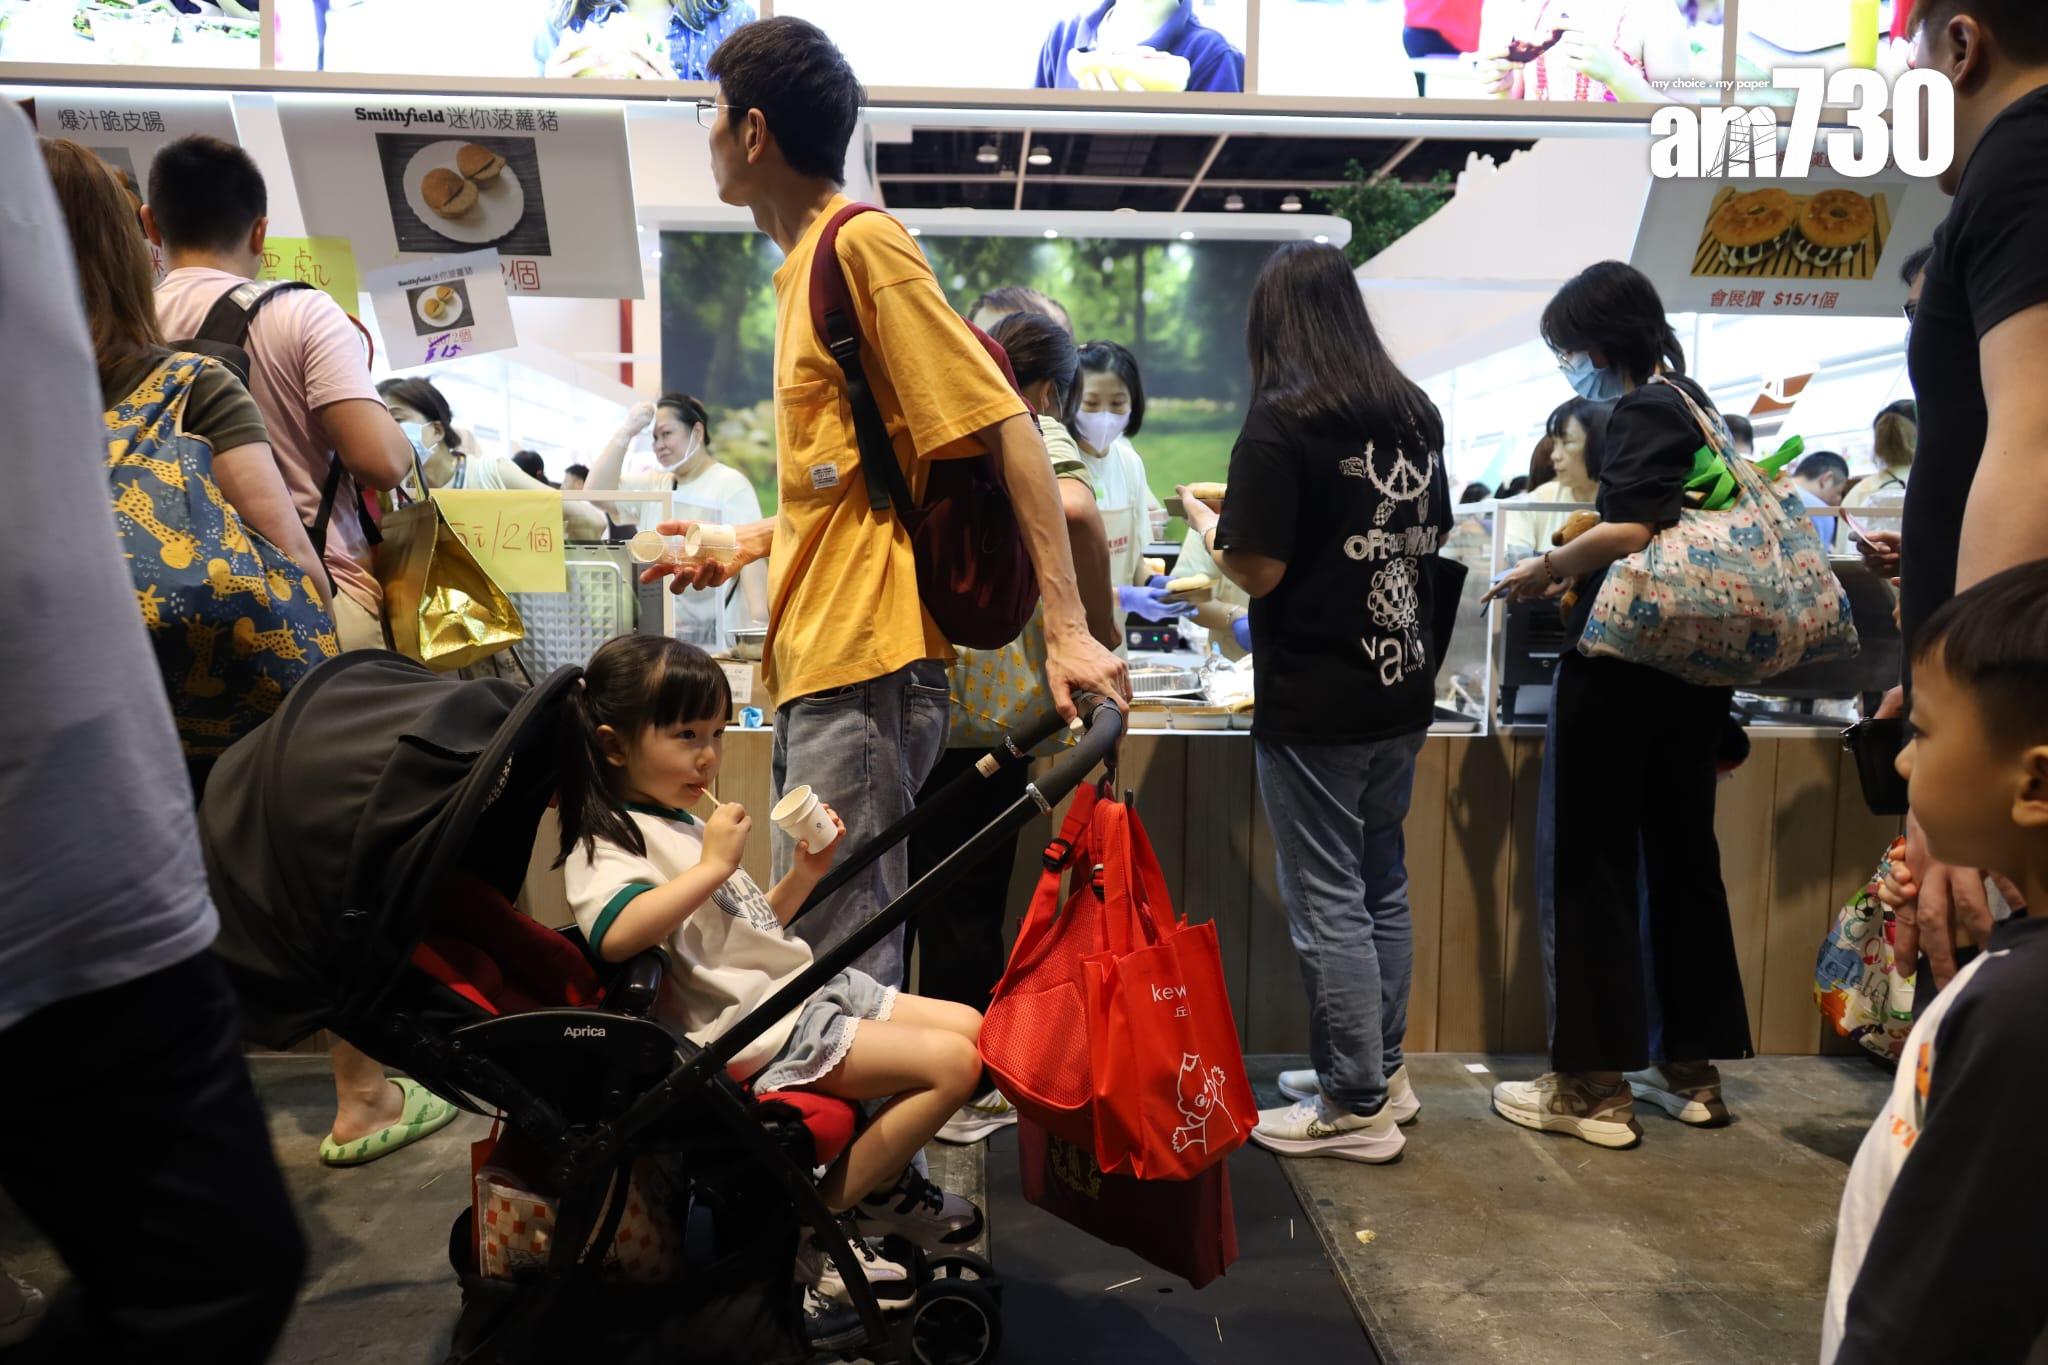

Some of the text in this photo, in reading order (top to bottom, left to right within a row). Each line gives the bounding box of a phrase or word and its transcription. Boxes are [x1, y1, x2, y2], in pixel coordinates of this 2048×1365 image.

[57, 109, 166, 133] 爆汁脆皮腸
[355, 106, 560, 132] Smithfield 迷你菠蘿豬
[500, 260, 541, 291] 個
[563, 1025, 606, 1039] Aprica
